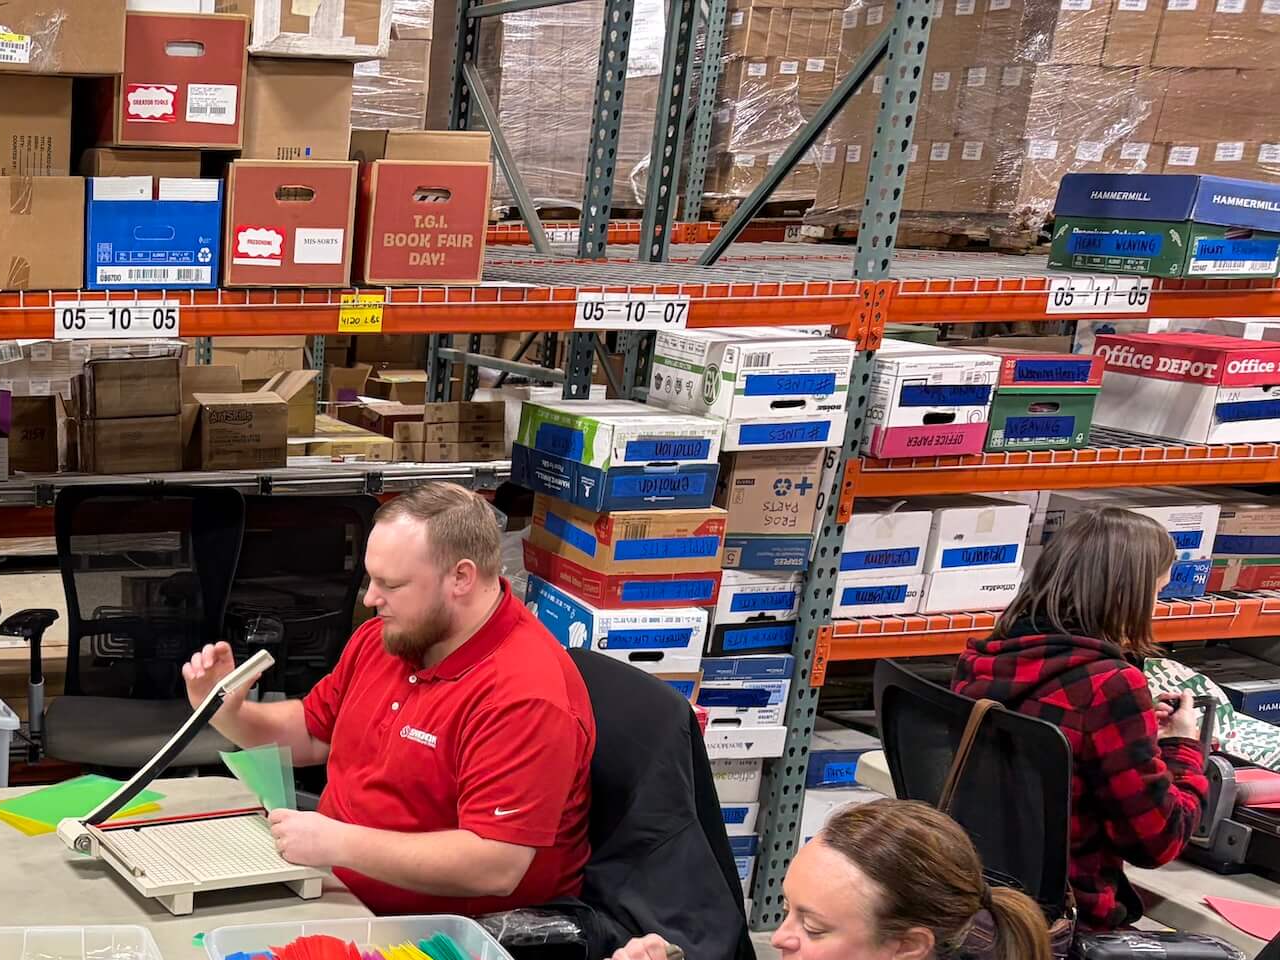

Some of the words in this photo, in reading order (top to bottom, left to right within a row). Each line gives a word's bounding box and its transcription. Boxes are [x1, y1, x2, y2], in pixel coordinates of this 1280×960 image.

[1090, 191, 1150, 200] HAMMERMILL
[414, 215, 448, 229] T.G.I.
[384, 233, 432, 248] BOOK
[437, 234, 474, 248] FAIR
[409, 254, 446, 267] DAY!
[1053, 286, 1148, 307] 05-11-05
[62, 307, 176, 330] 05-10-05
[582, 301, 687, 323] 05-10-07
[341, 317, 361, 326] 4120
[1095, 344, 1154, 369] Office
[1155, 357, 1218, 379] DEPOT
[1227, 359, 1275, 374] Office
[907, 435, 933, 447] PAPER
[933, 434, 964, 446] OFFICE
[762, 501, 799, 513] PARTS
[763, 516, 797, 527] FROG
[727, 552, 736, 565] 5
